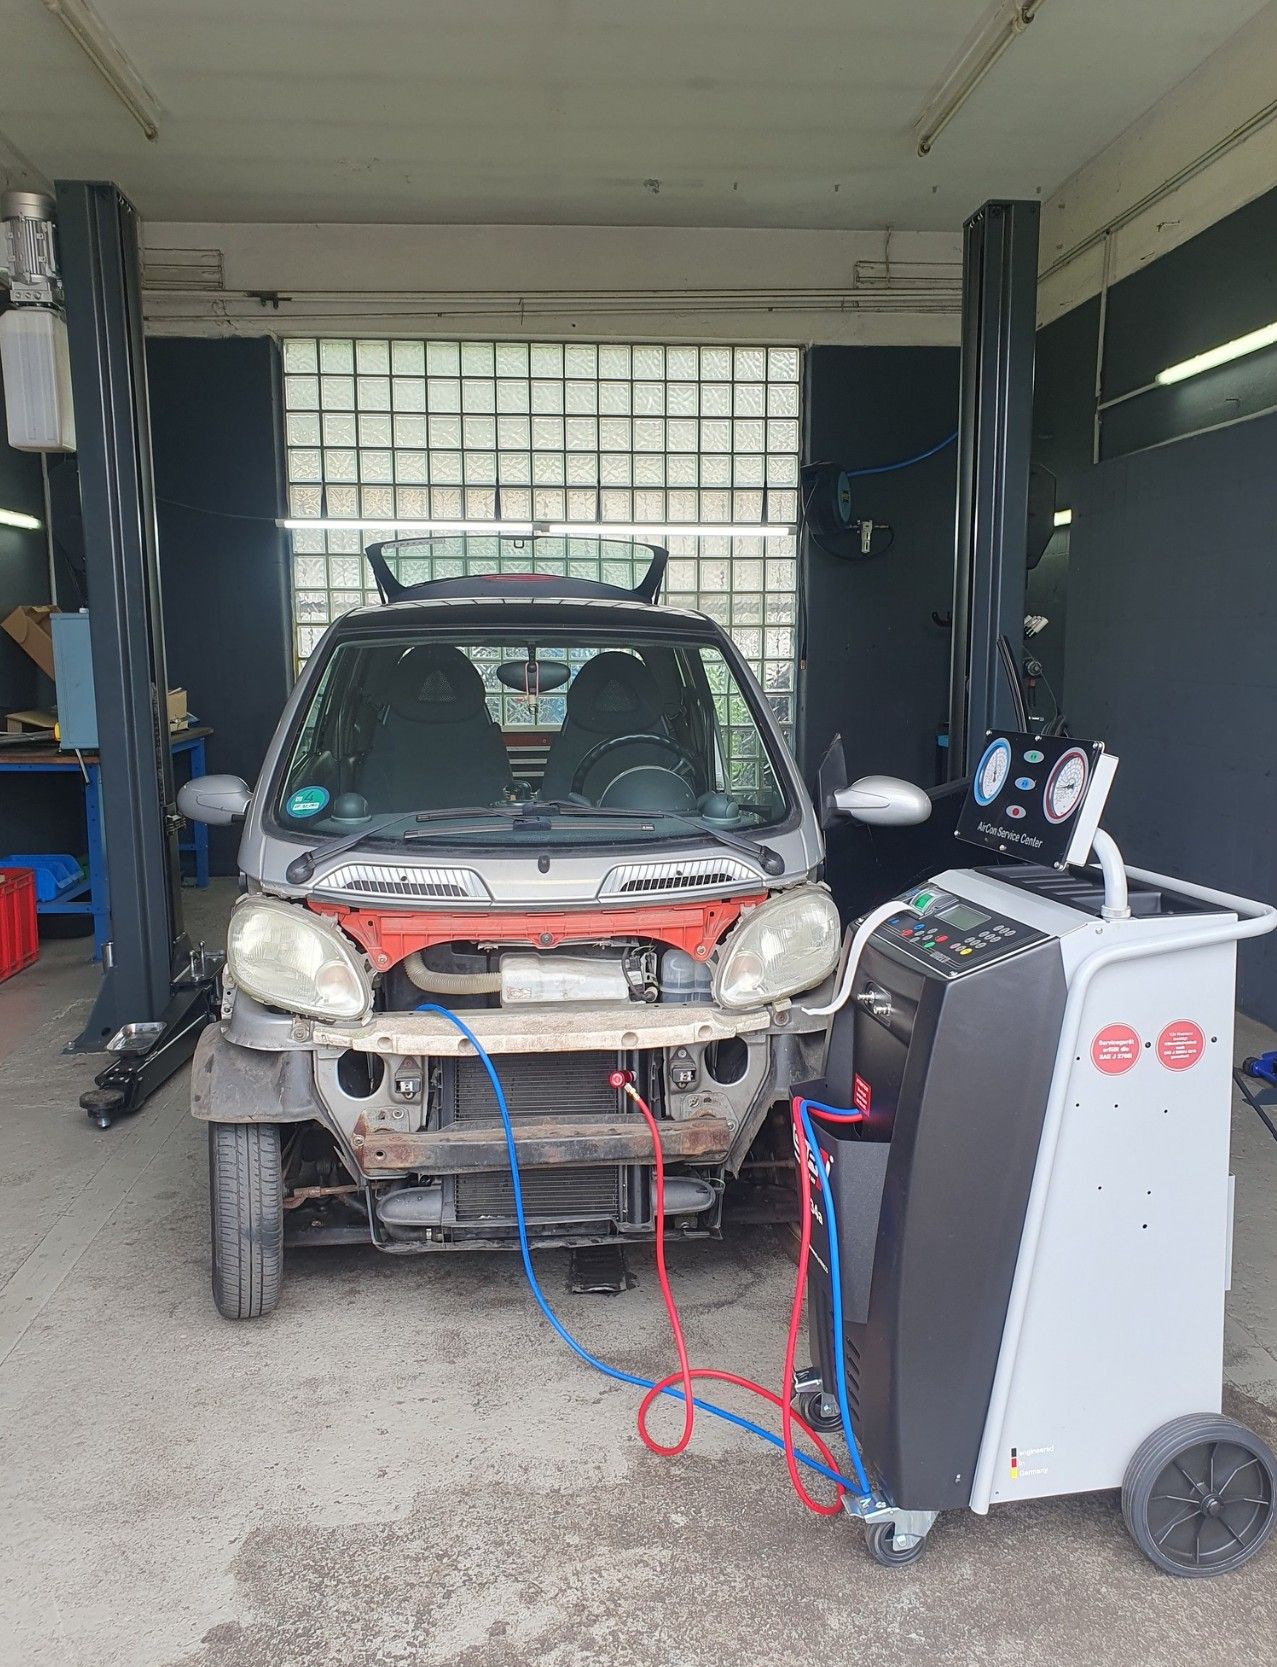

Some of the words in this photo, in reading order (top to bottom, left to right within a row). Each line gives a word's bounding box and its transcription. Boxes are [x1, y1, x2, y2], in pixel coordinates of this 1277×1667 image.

[977, 821, 998, 835] AirCon
[997, 826, 1020, 842] Service
[1020, 833, 1043, 848] Center
[1019, 1444, 1056, 1457] engineered
[1019, 1467, 1049, 1477] Germany
